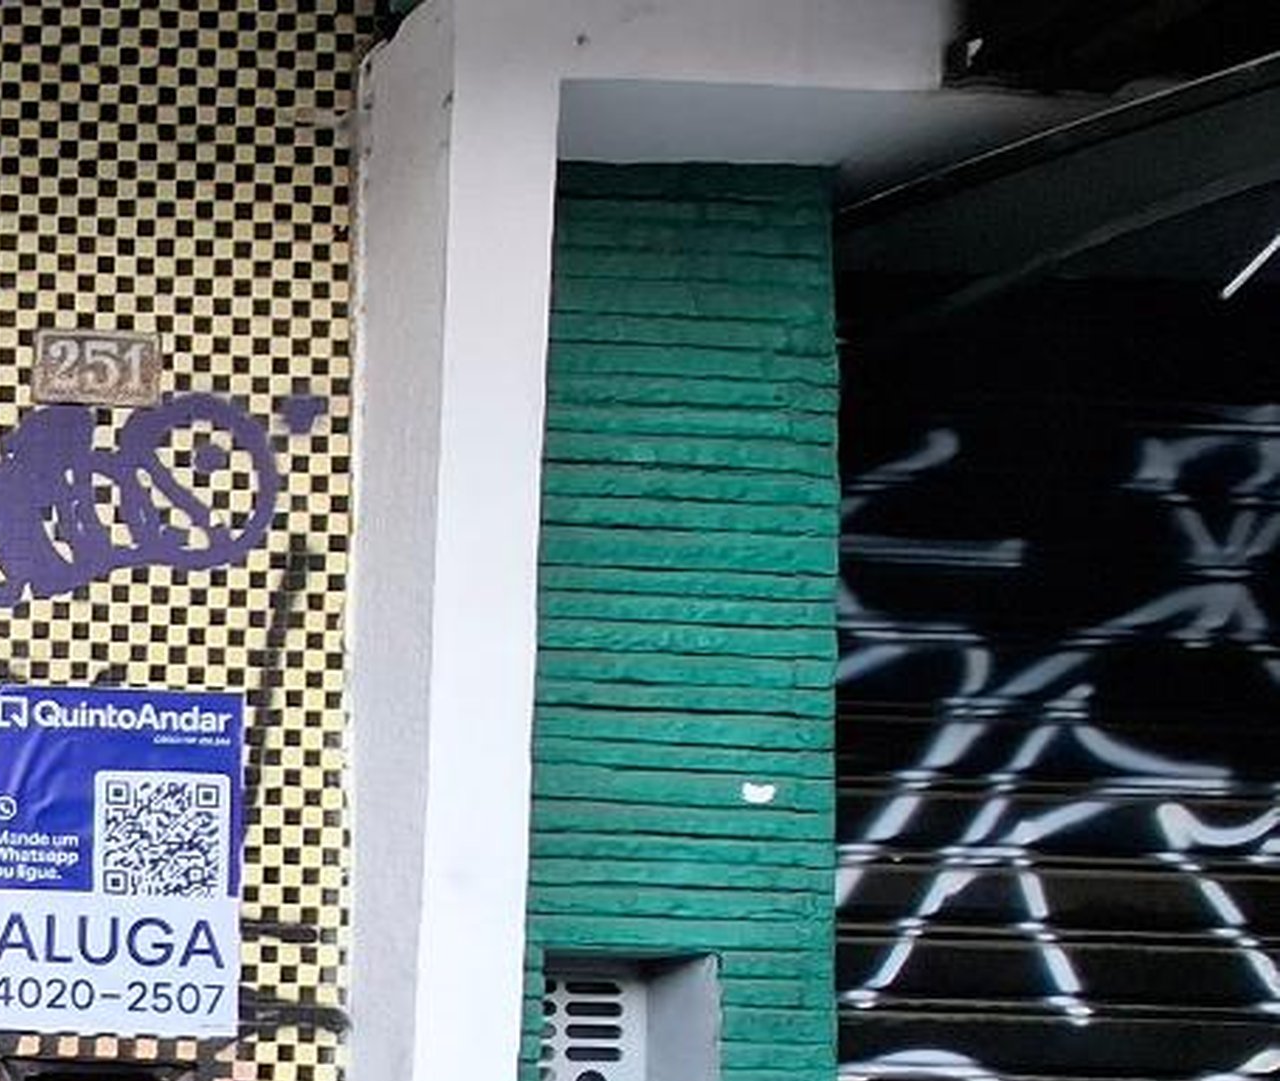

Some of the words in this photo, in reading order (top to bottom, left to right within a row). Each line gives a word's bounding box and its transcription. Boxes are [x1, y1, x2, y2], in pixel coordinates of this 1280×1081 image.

[48, 339, 146, 394] 251
[34, 699, 234, 732] QuintoAndar
[52, 835, 79, 847] um
